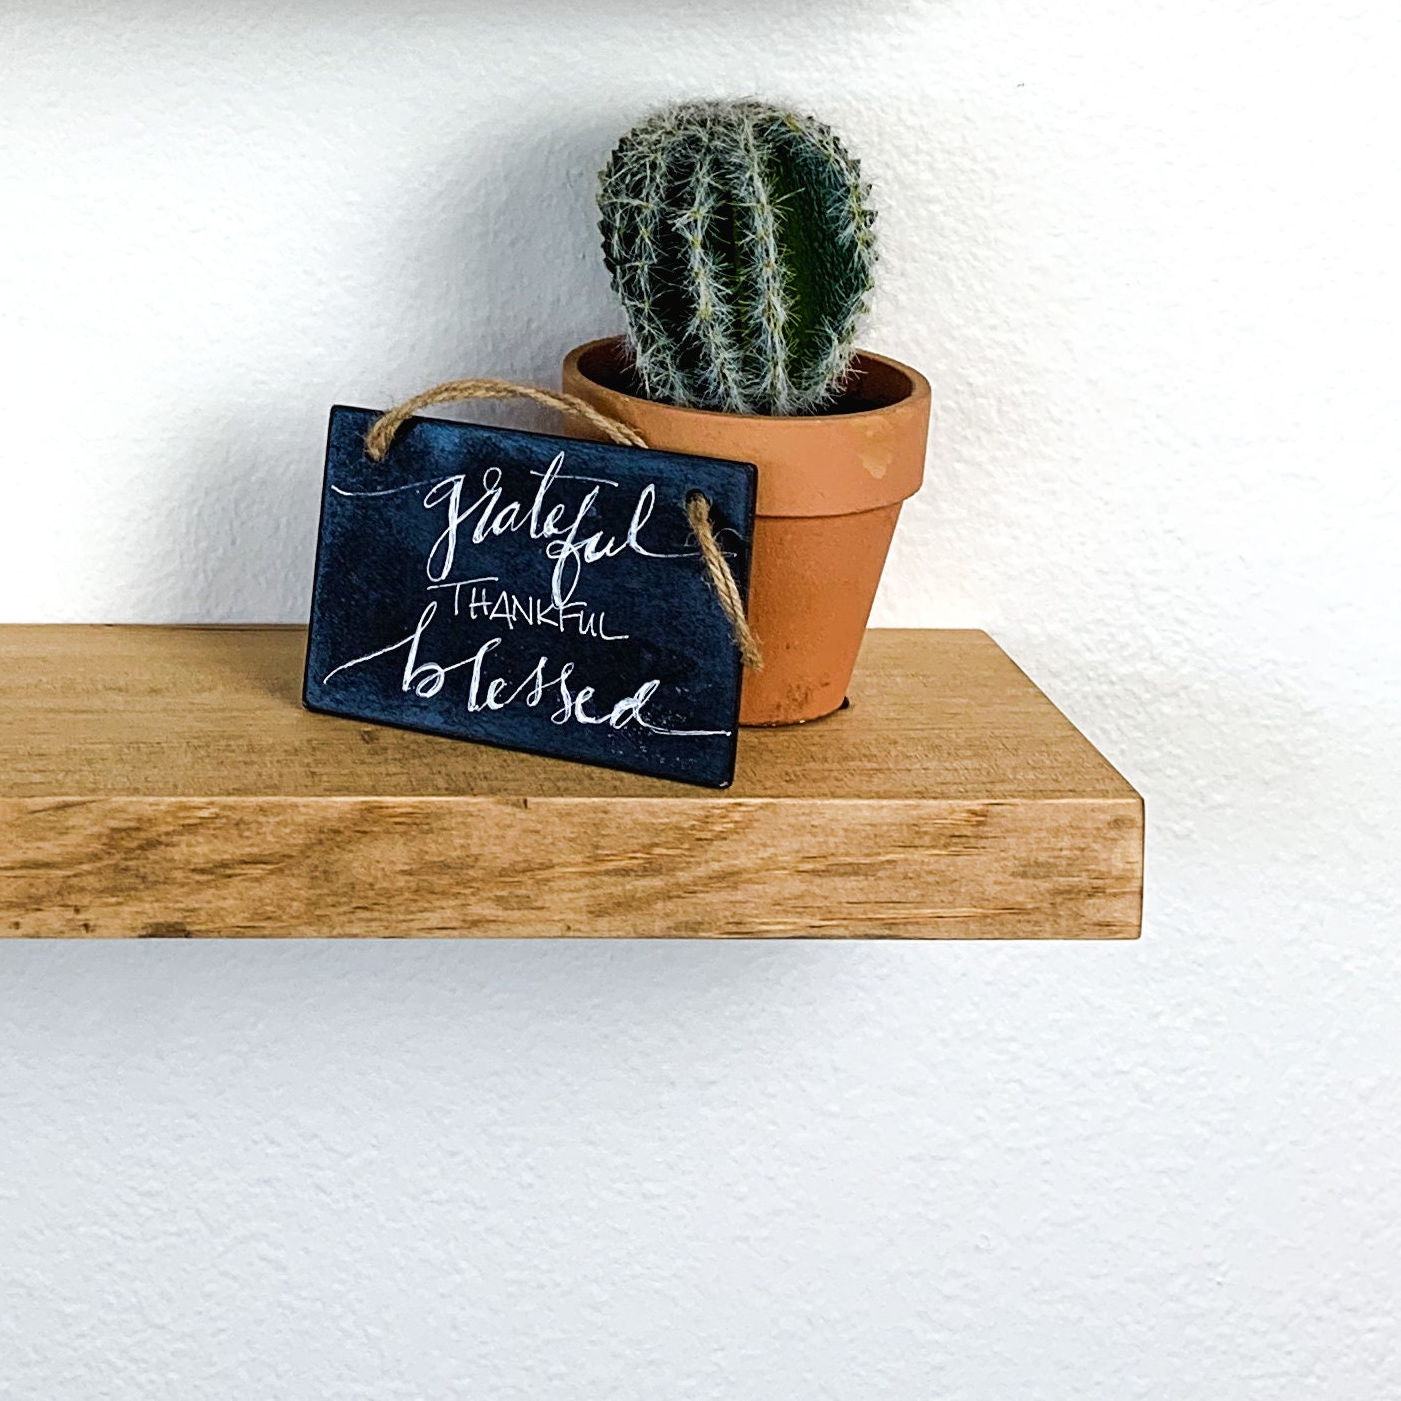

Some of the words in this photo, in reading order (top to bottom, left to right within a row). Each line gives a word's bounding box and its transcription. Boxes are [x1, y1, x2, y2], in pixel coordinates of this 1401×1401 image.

[331, 451, 737, 608] grateful
[323, 601, 732, 736] blessed
[427, 576, 629, 640] THANKFUL
